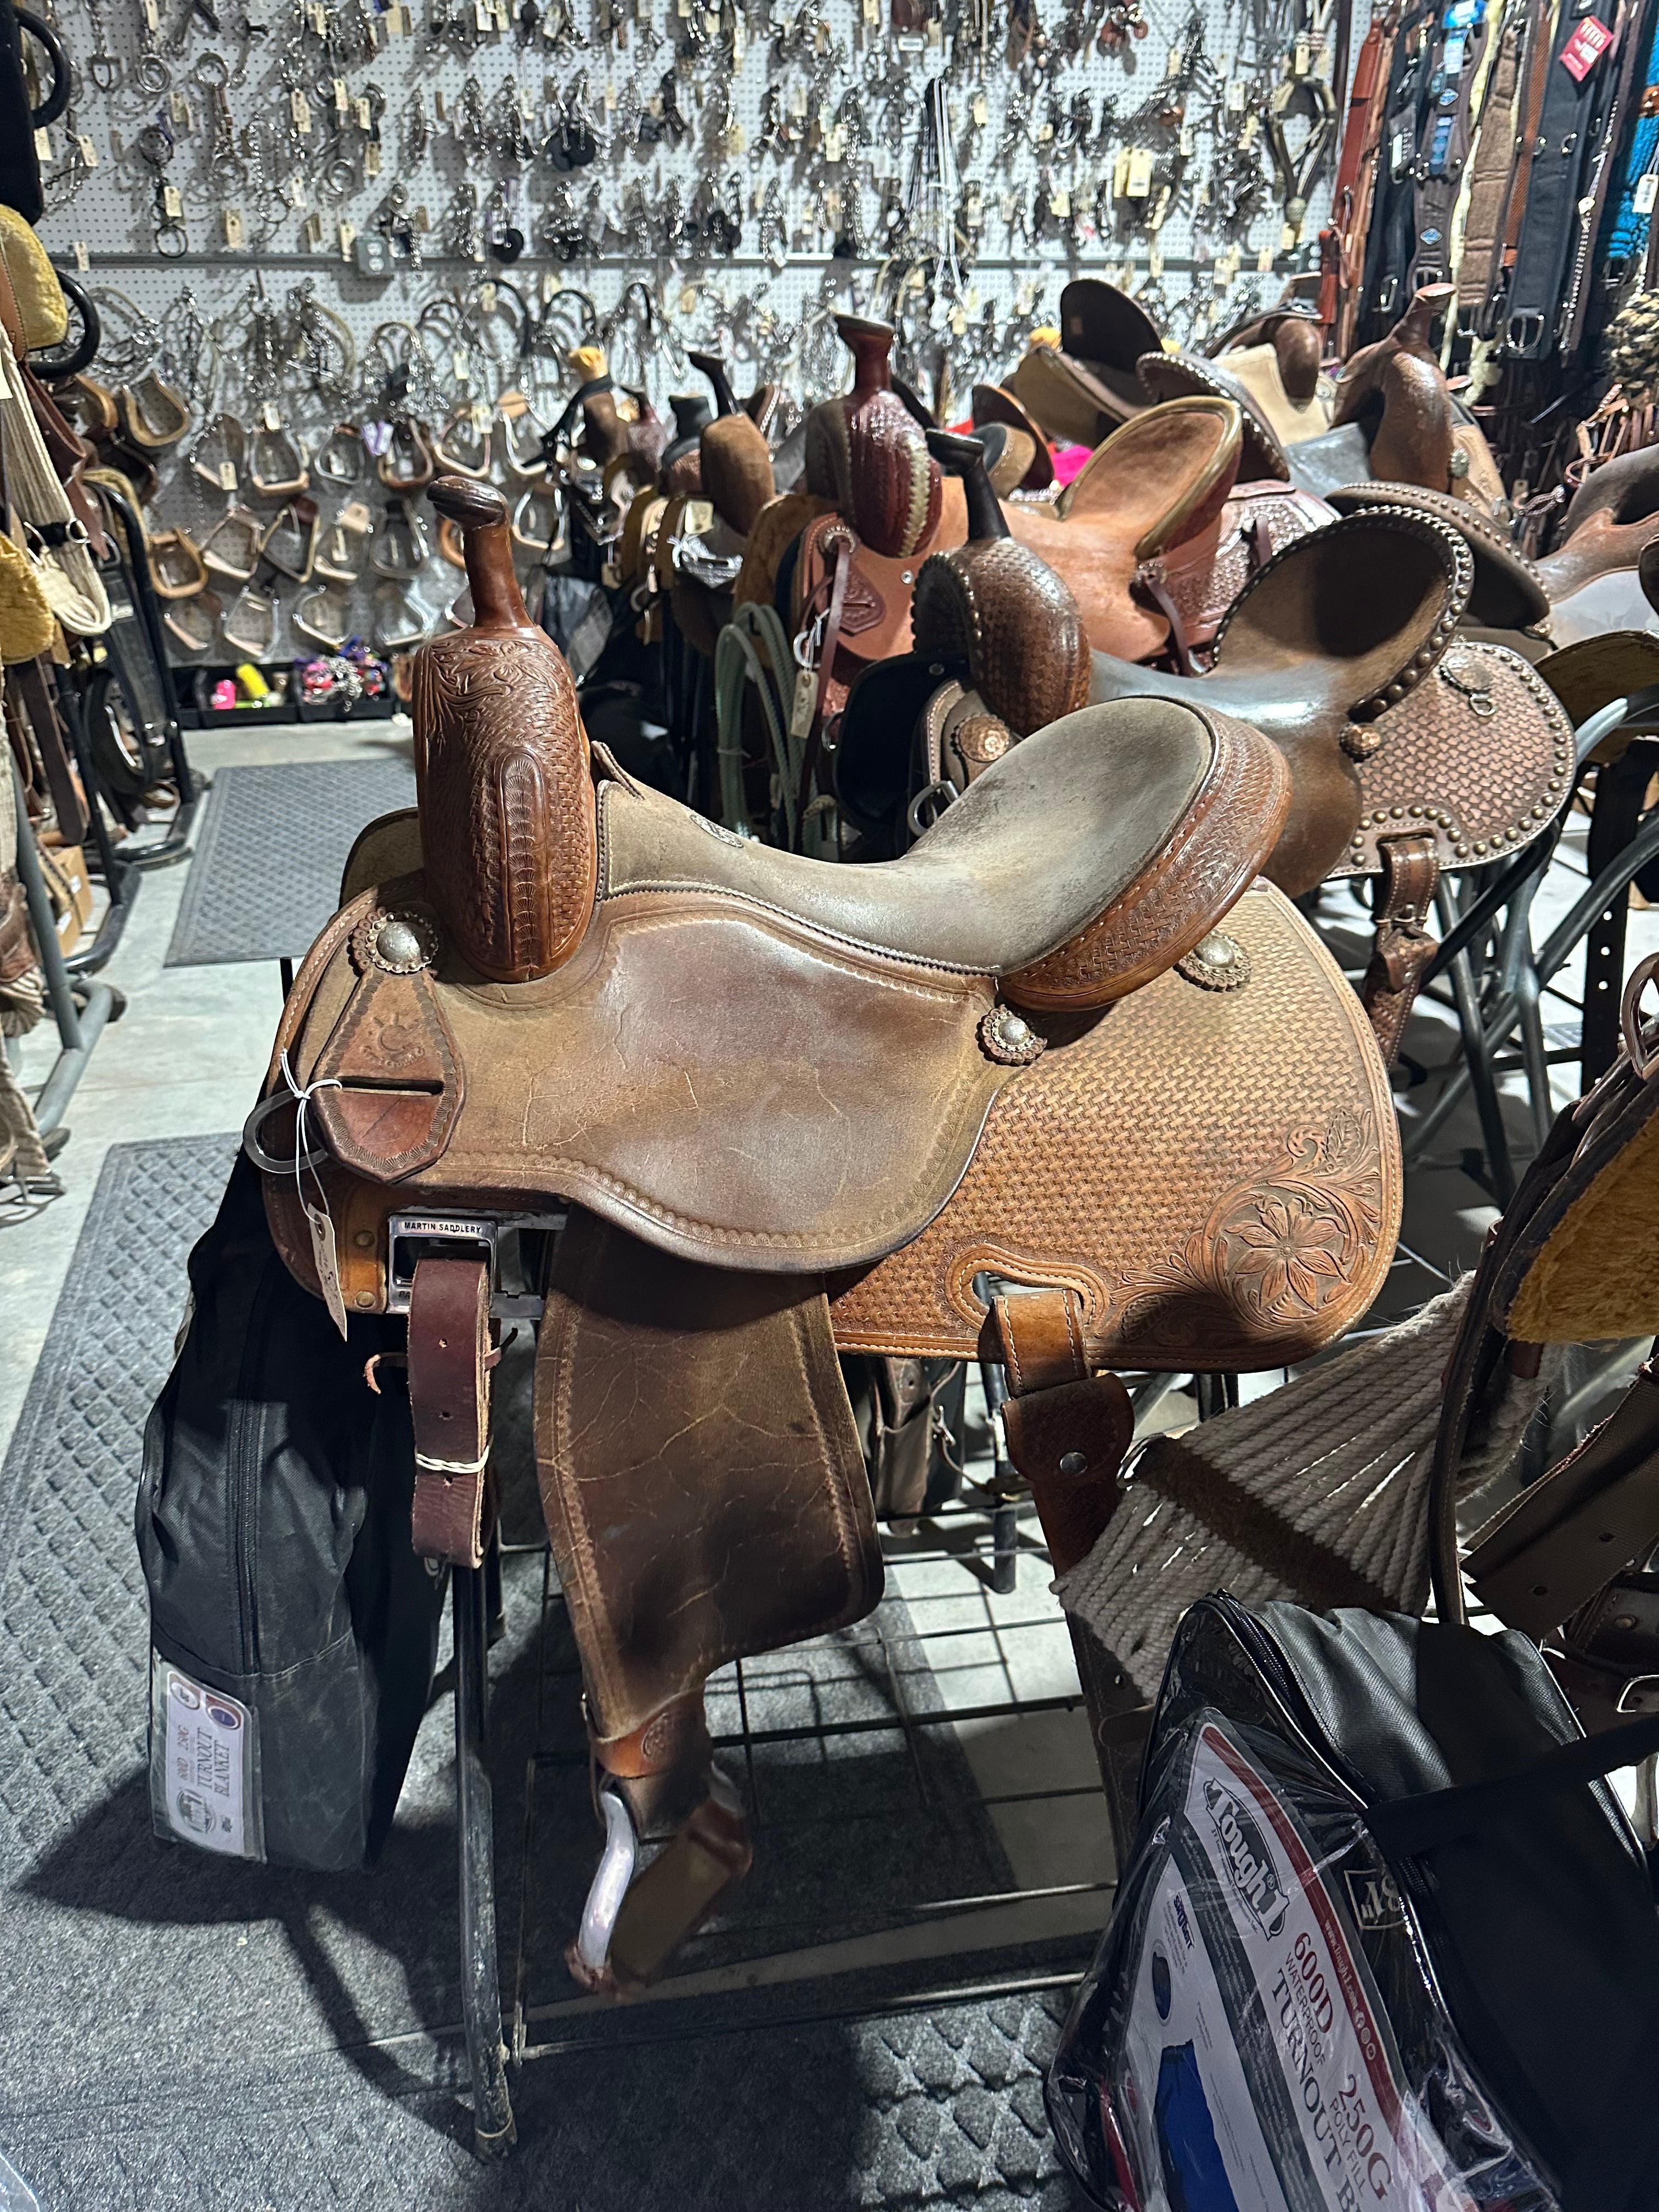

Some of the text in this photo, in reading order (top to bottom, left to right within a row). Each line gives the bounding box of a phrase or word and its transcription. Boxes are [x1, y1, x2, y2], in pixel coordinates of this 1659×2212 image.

[404, 1222, 481, 1233] MARTIN SADDLERY
[198, 1727, 213, 1790] TURNOUT
[215, 1740, 230, 1797] BLANKET
[1272, 1967, 1342, 2172] TURNOUT
[1285, 1951, 1325, 2066] WATERPROOF
[1330, 2096, 1351, 2146] POLY
[1347, 2149, 1365, 2198] FILL
[1294, 1932, 1333, 2033] 600D
[1338, 2073, 1392, 2200] 250G
